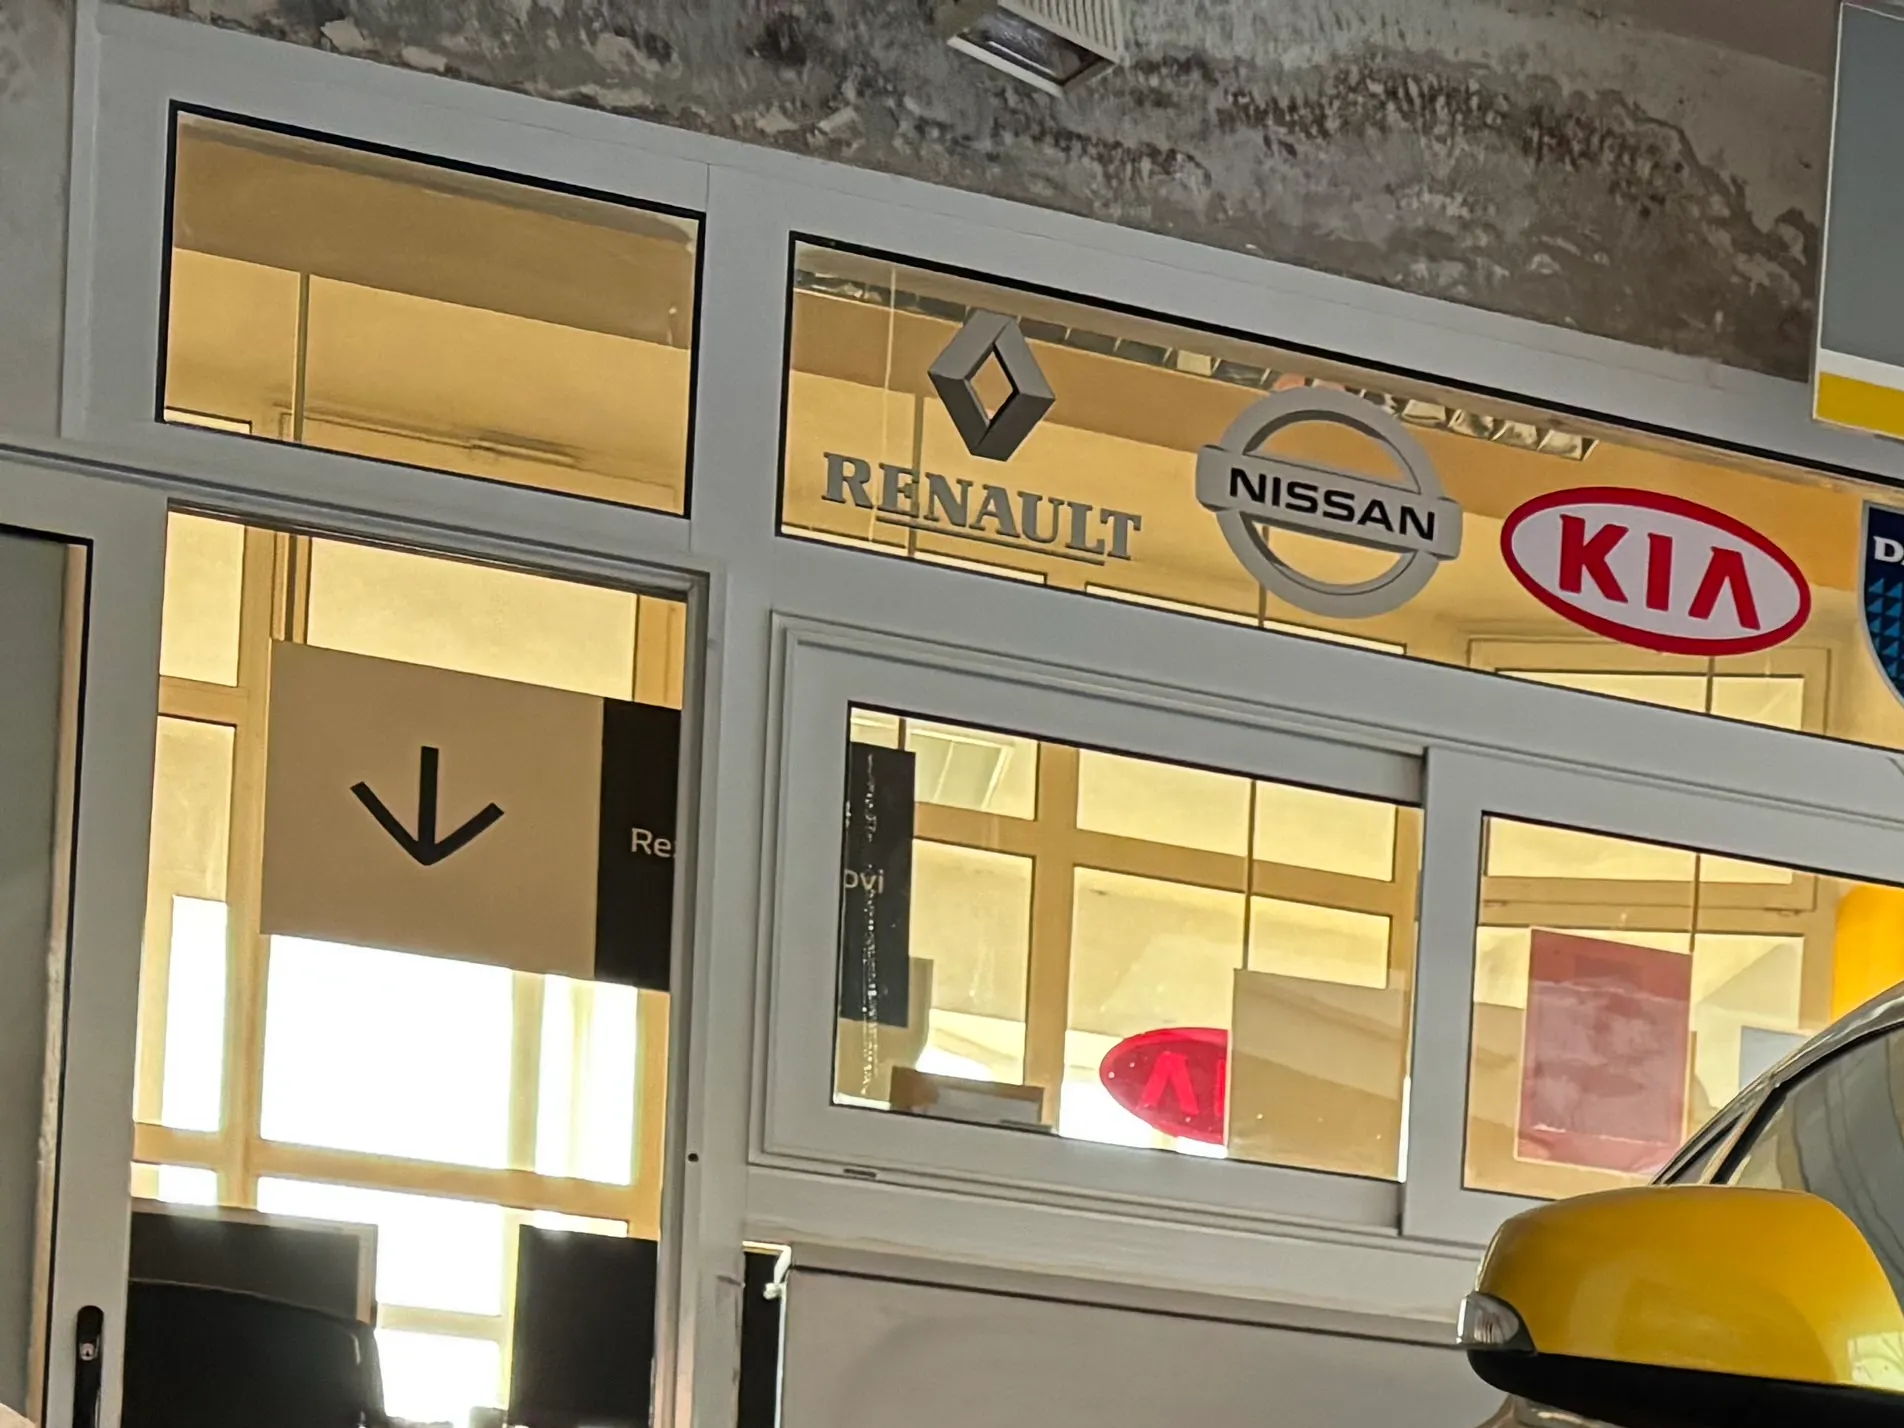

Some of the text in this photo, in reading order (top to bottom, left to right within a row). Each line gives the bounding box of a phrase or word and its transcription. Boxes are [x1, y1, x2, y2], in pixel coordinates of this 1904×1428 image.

[822, 451, 1142, 561] RENAULT
[1228, 467, 1437, 542] NISSAN
[1558, 513, 1761, 631] KIA
[631, 827, 675, 858] Re
